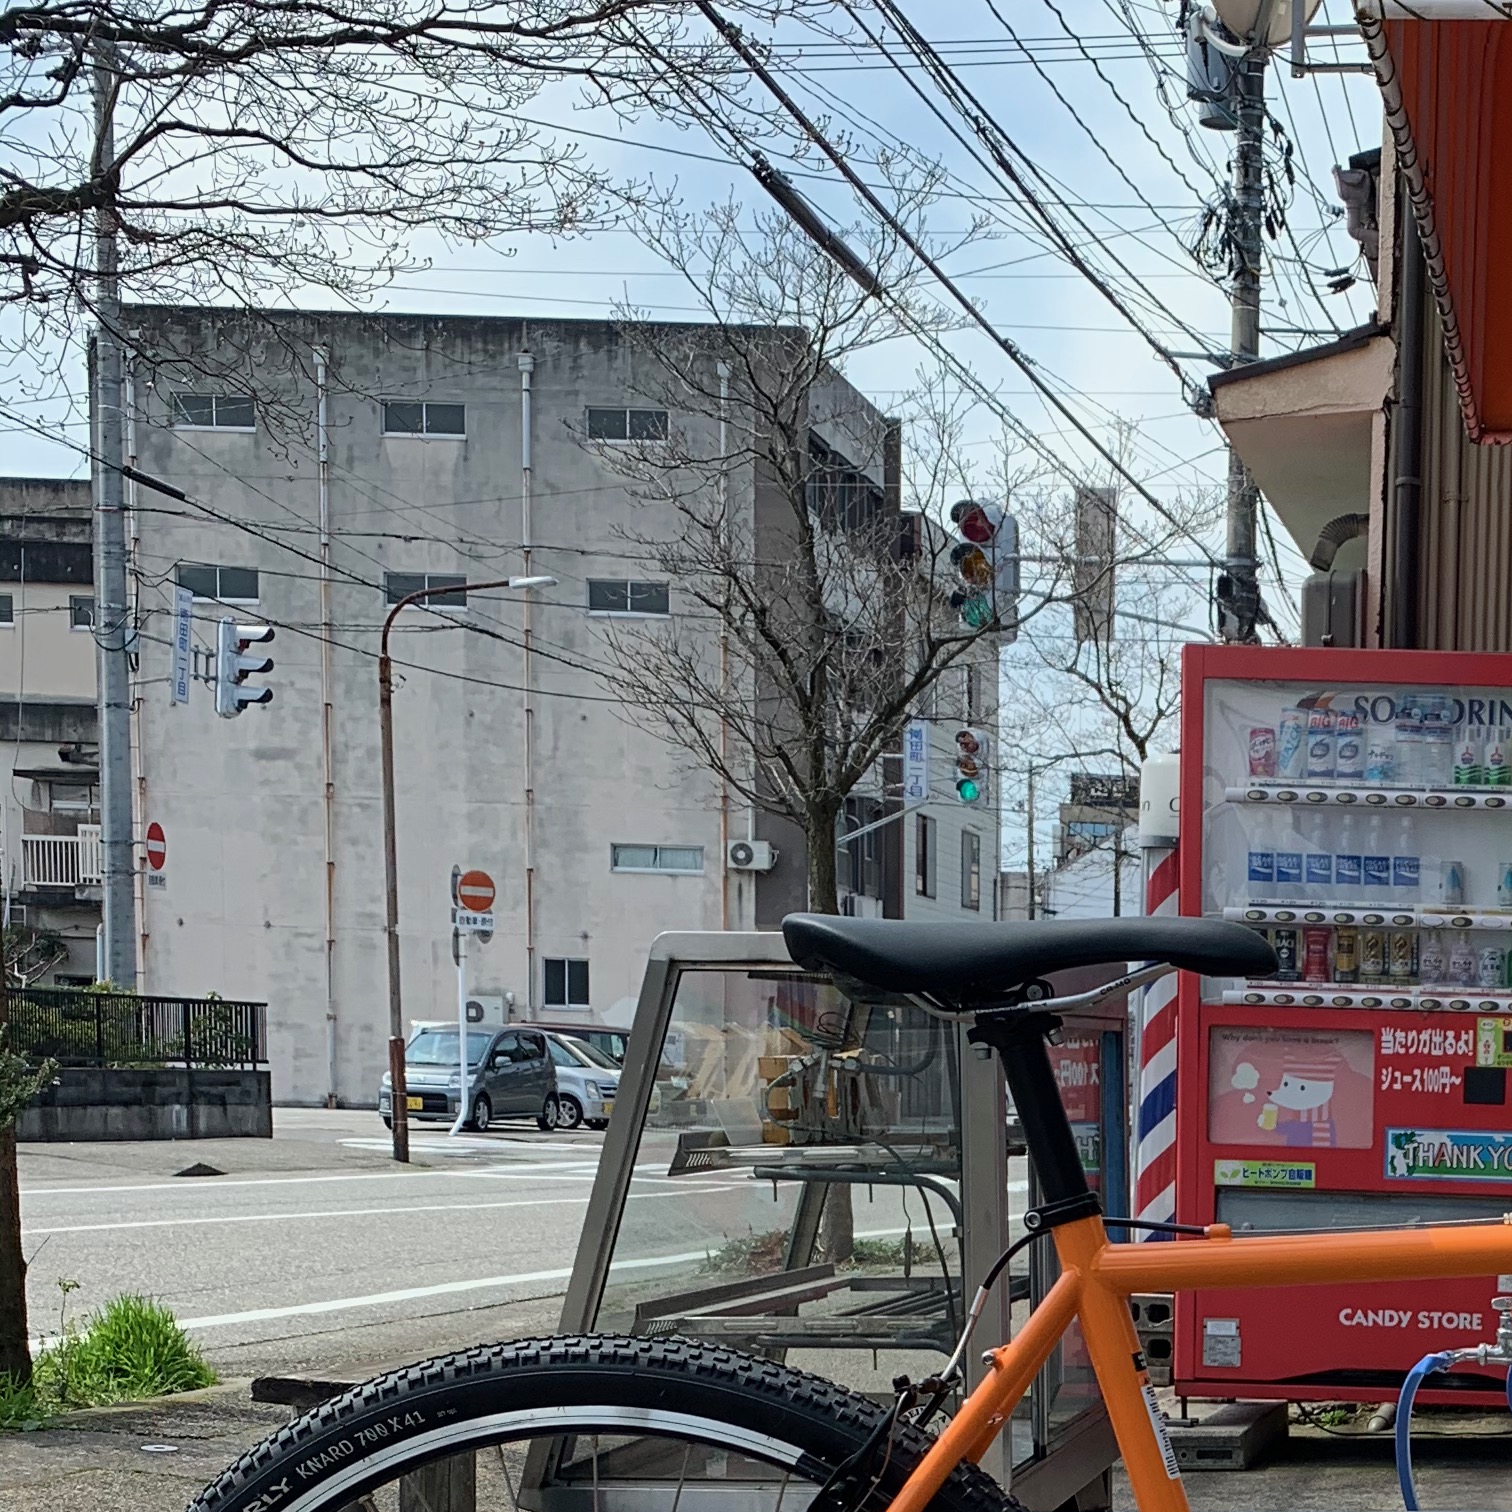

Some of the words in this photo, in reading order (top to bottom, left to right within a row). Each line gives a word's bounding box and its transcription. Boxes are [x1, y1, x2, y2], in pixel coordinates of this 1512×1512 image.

[1405, 1141, 1485, 1169] THANK
[1339, 1308, 1413, 1328] CANDY
[1417, 1311, 1484, 1331] STORE
[295, 1438, 355, 1480] KNARD
